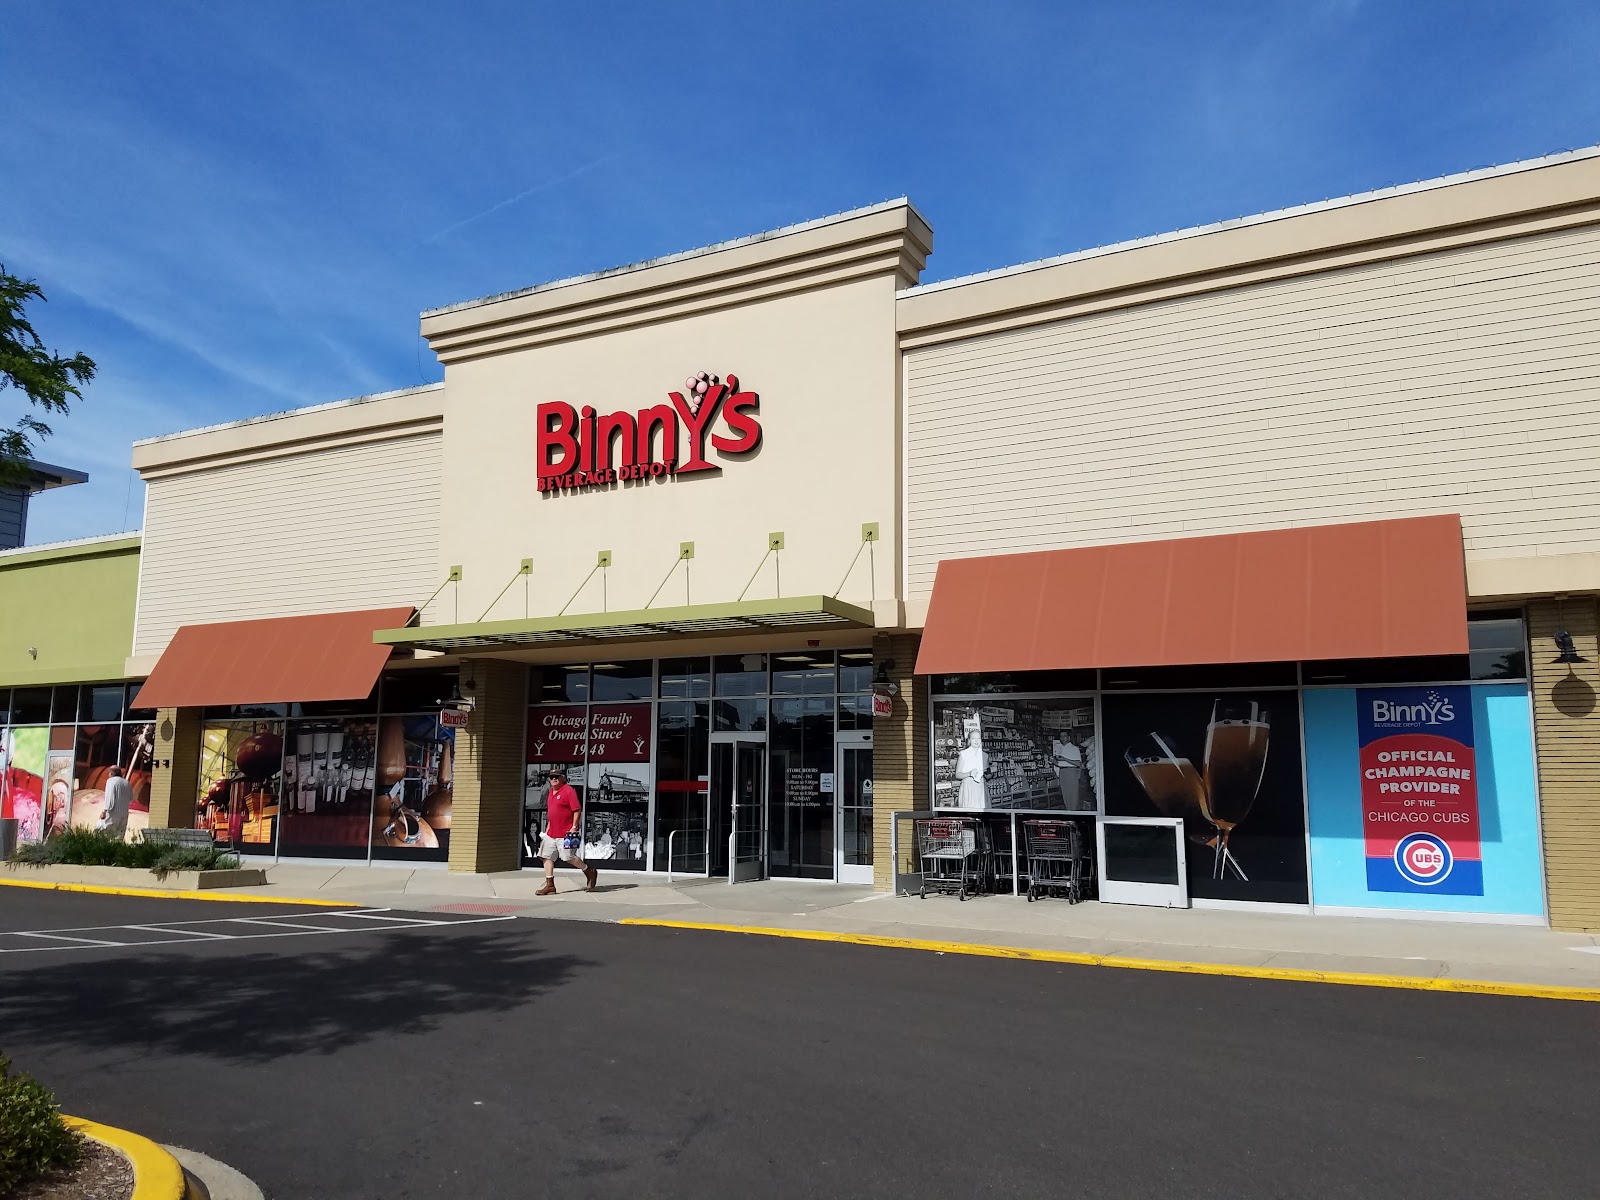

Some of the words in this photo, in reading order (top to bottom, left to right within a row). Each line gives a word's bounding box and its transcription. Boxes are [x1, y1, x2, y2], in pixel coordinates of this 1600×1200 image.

[537, 468, 614, 492] BEVERAGE
[619, 459, 673, 481] DEPOT
[542, 714, 587, 728] Chicago
[591, 712, 632, 727] Family
[548, 729, 587, 741] Owned
[590, 728, 622, 740] Since
[572, 743, 605, 756] 1948
[1377, 750, 1456, 763] OFFICIAL
[1364, 766, 1471, 781] CHAMPAGNE
[1380, 782, 1460, 795] PROVIDER
[1368, 812, 1429, 823] CHICAGO
[1433, 812, 1470, 824] CUBS
